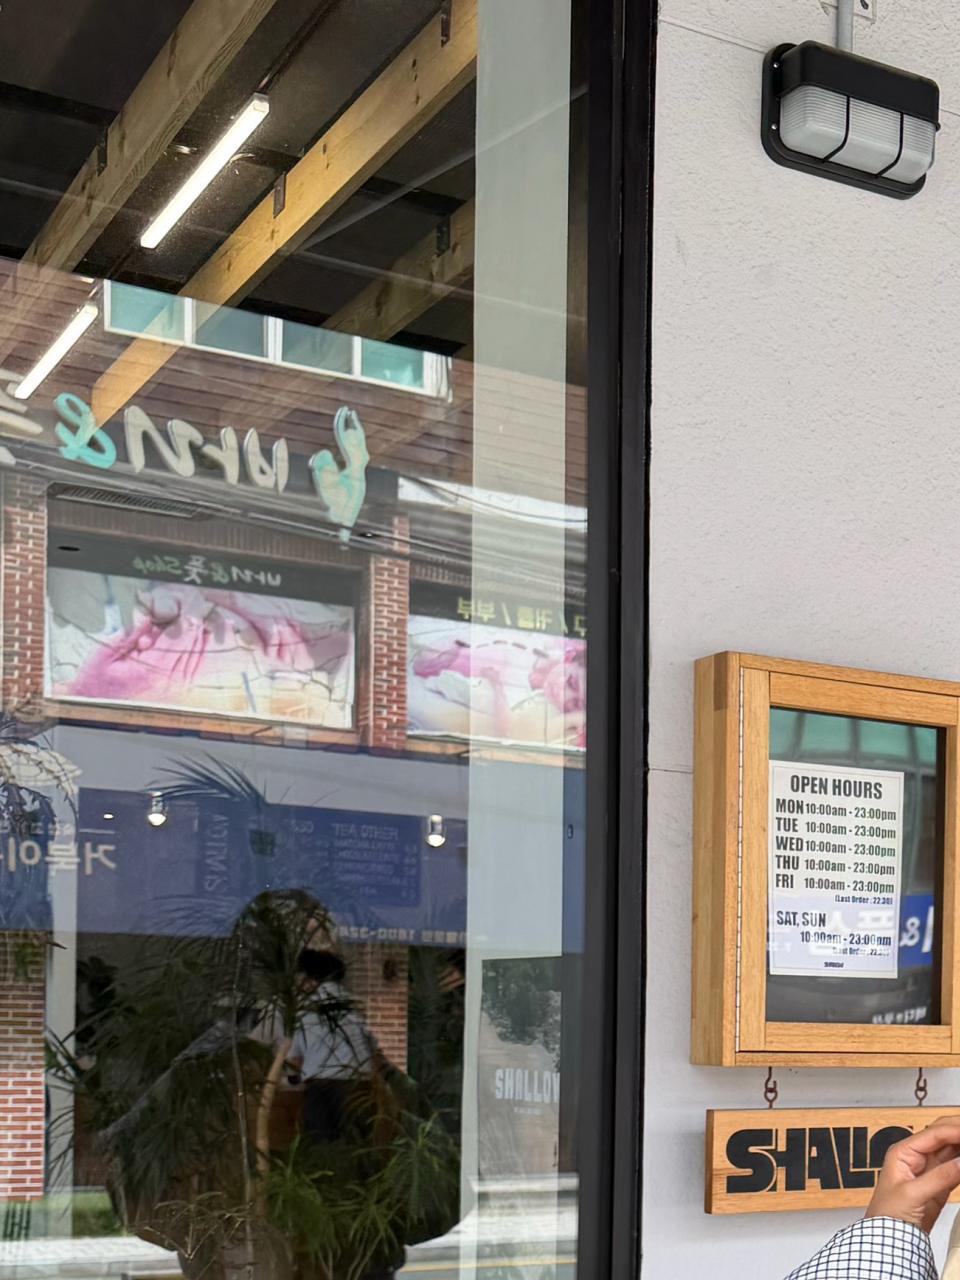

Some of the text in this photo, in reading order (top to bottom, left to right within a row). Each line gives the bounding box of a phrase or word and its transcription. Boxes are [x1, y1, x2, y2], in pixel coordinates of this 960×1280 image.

[790, 774, 883, 800] OPEN HOURS
[776, 798, 804, 814] MON
[805, 803, 847, 817] 10:00am
[854, 807, 897, 821] 23:00pm
[775, 817, 798, 832] TUE
[805, 821, 847, 835] 10:00am
[854, 825, 896, 839] 23:00pm
[775, 835, 804, 852] WED
[805, 840, 847, 854] 10:00am
[854, 844, 896, 857] 23:00pm
[775, 855, 799, 870] THU
[804, 859, 846, 872] 10:00am
[853, 862, 895, 876] 23:00pm
[775, 873, 794, 889] FRI
[804, 877, 845, 891] 10:00am
[852, 880, 895, 894] 23:00pm
[776, 910, 826, 927] SAT, SUN
